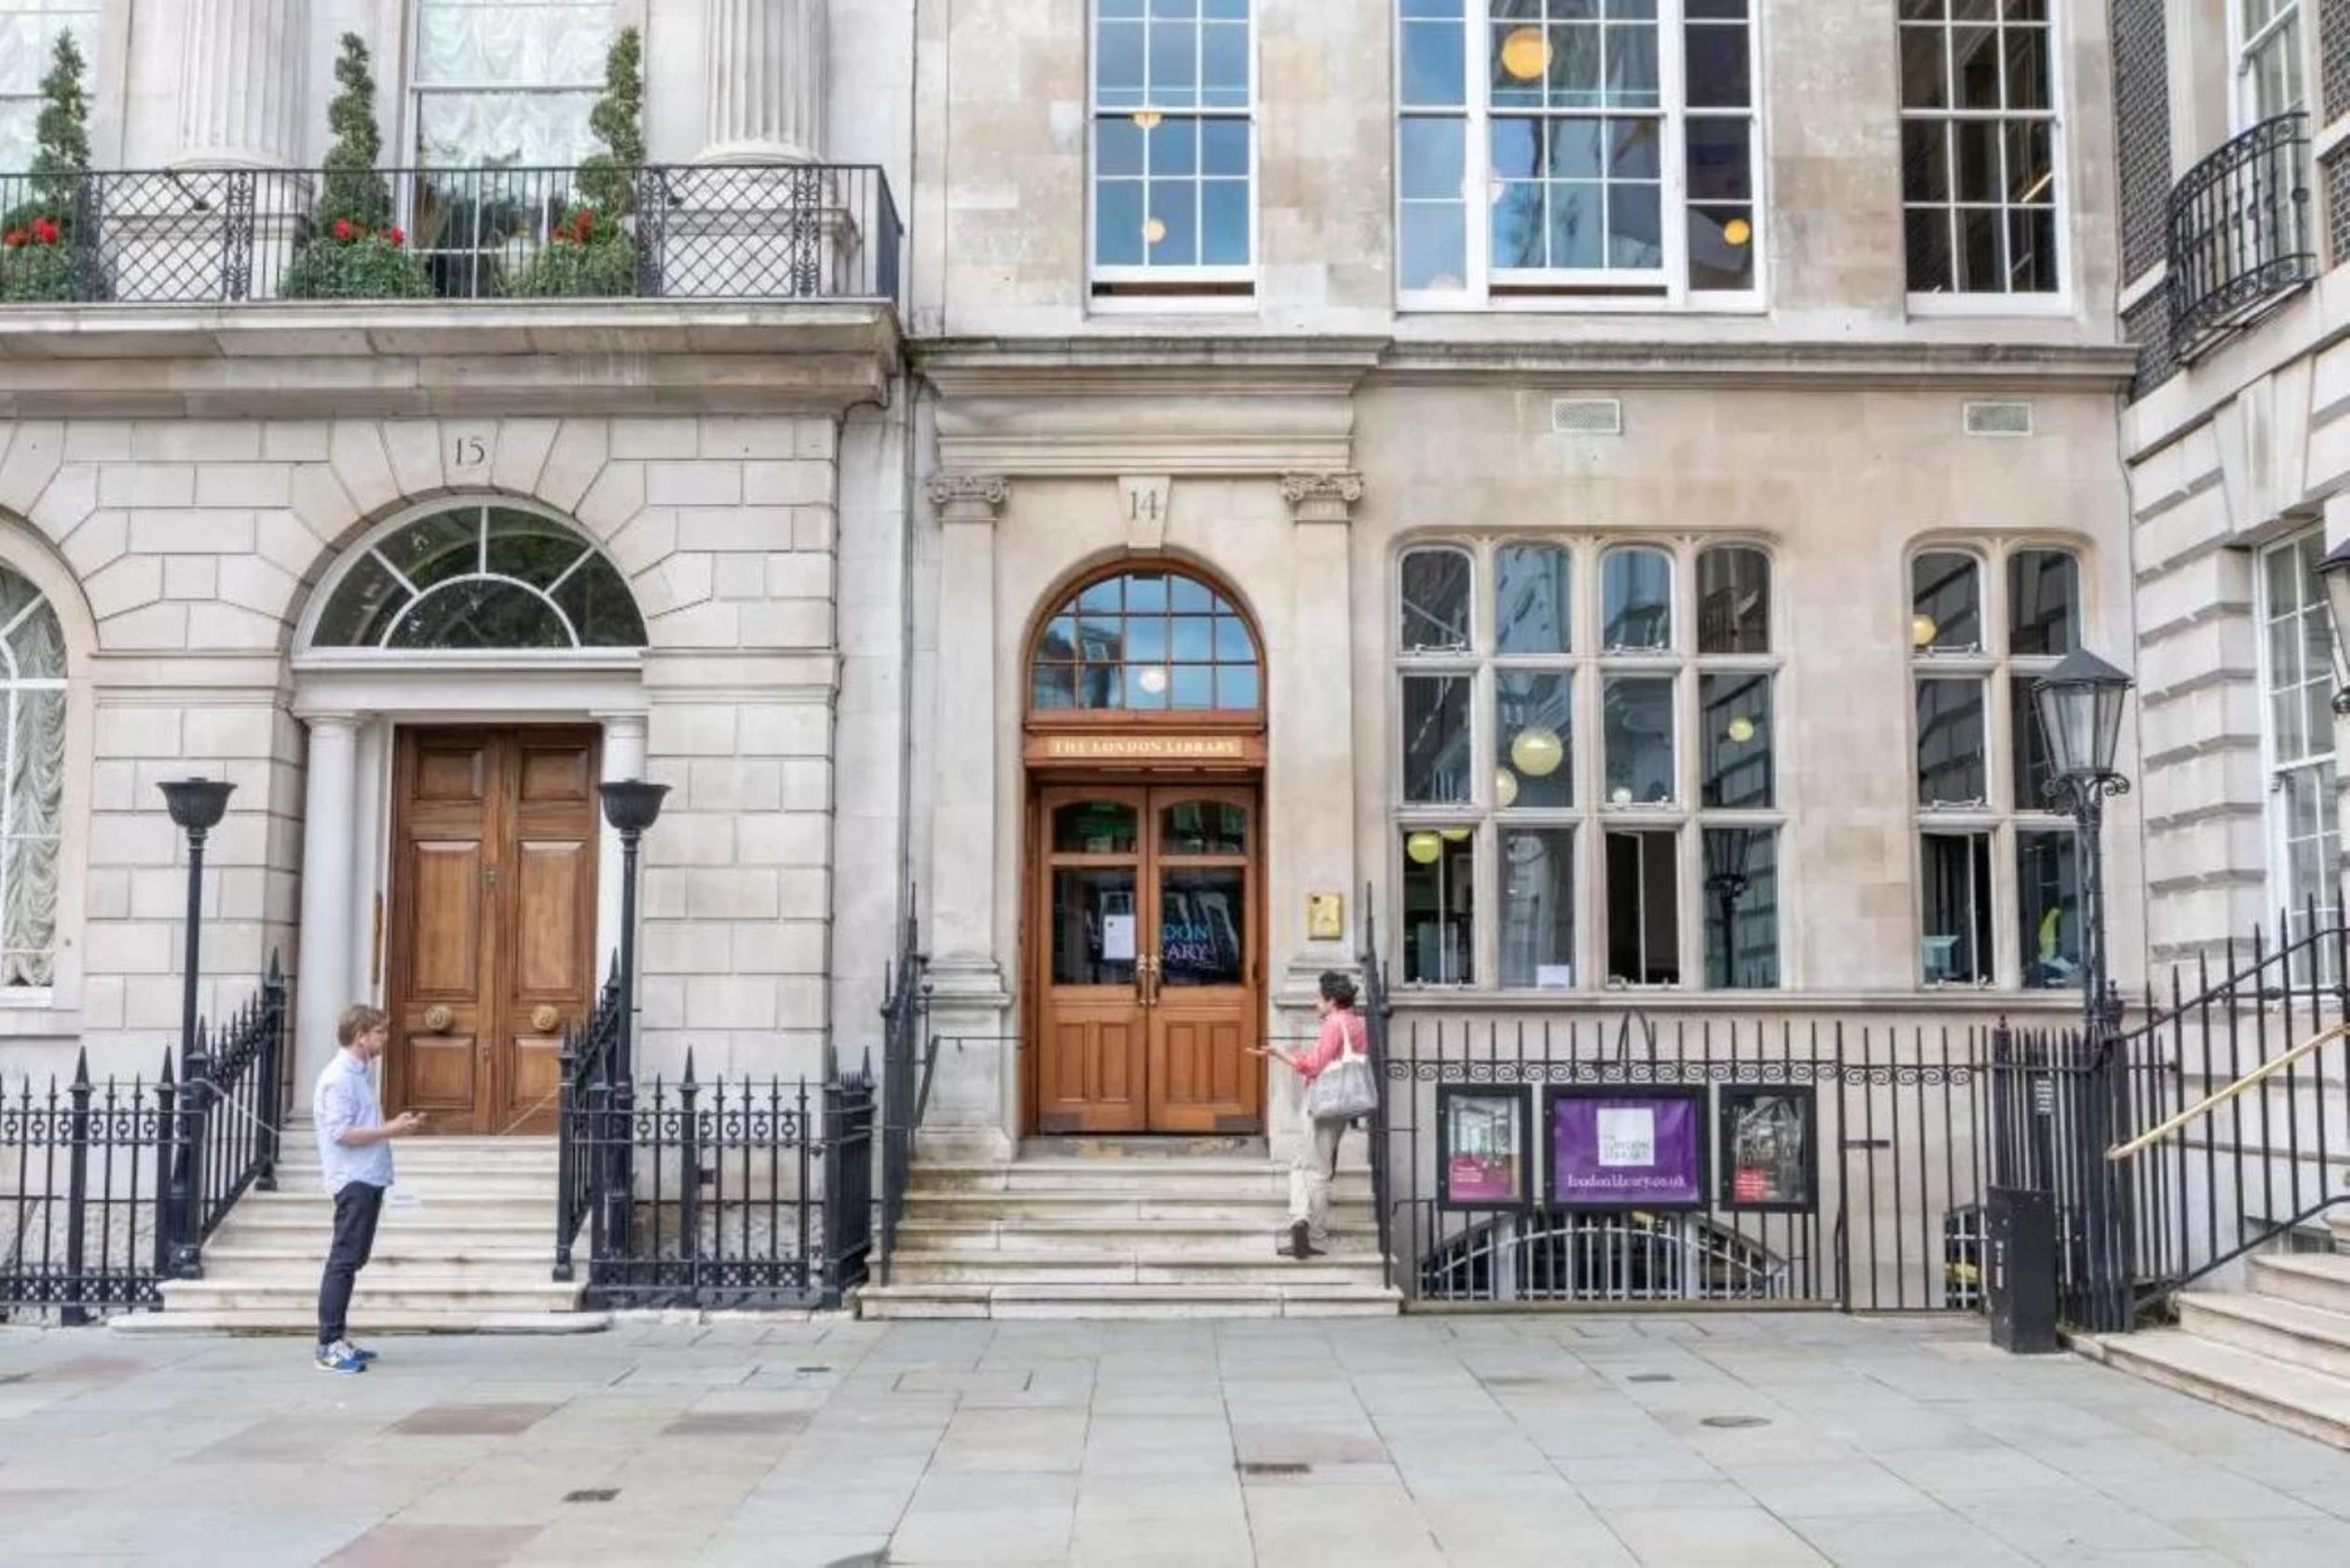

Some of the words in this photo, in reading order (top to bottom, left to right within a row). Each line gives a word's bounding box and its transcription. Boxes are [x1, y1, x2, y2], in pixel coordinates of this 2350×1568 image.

[456, 435, 485, 466] 15
[1130, 490, 1162, 521] 14
[1054, 740, 1085, 754] THE
[1092, 740, 1162, 754] LONDON
[1166, 740, 1236, 754] LIBRARY
